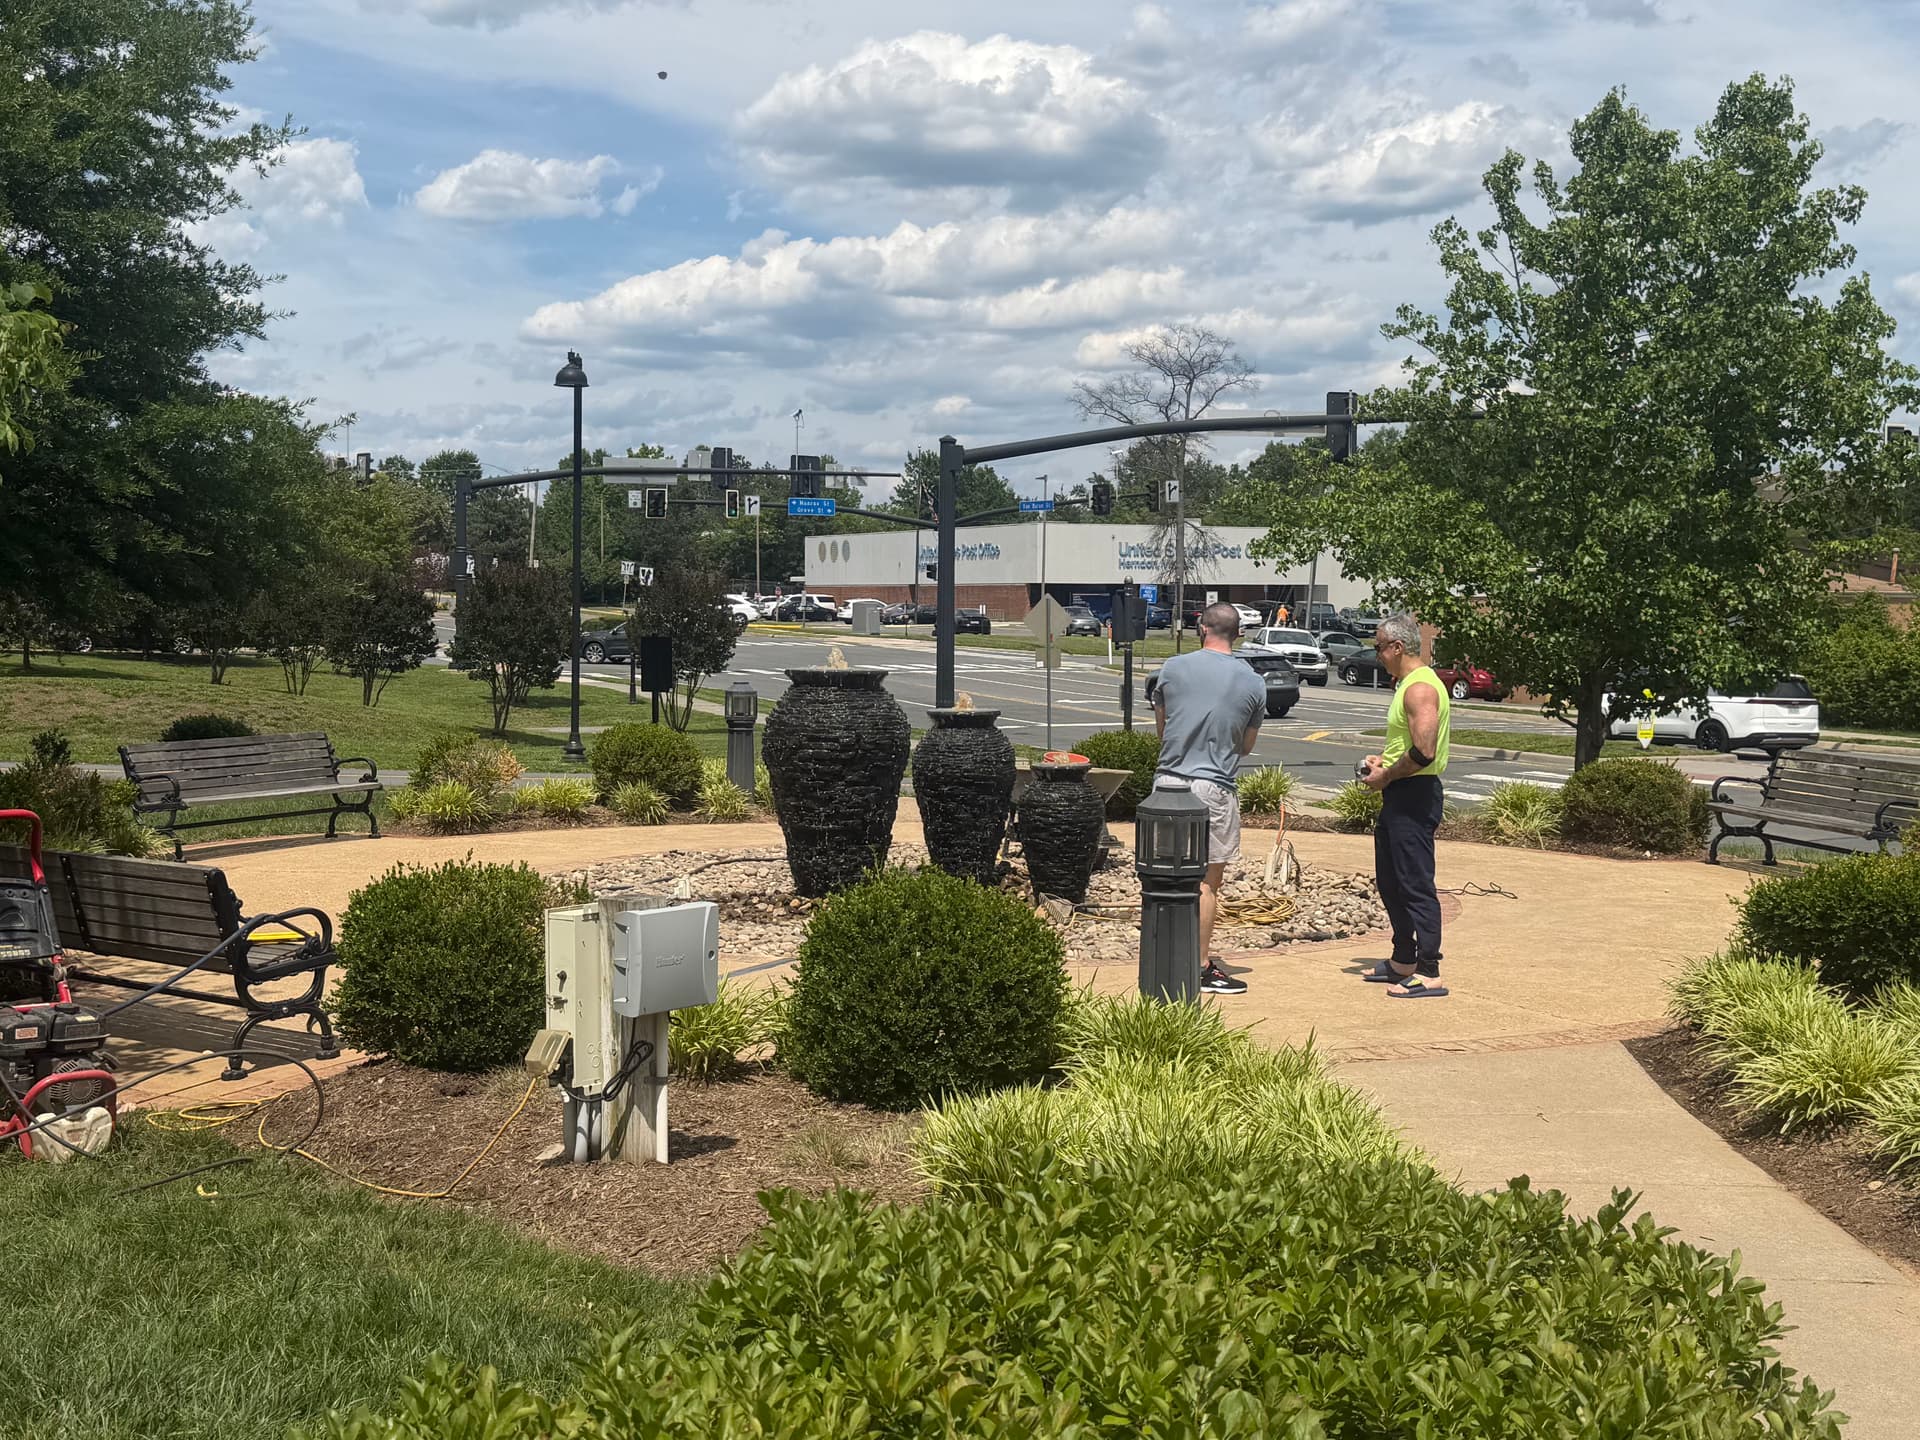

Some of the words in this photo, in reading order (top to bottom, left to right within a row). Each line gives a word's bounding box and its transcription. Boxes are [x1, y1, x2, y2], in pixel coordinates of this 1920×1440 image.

[1119, 541, 1162, 559] United
[1164, 542, 1209, 560] Stes
[1211, 542, 1242, 560] Post
